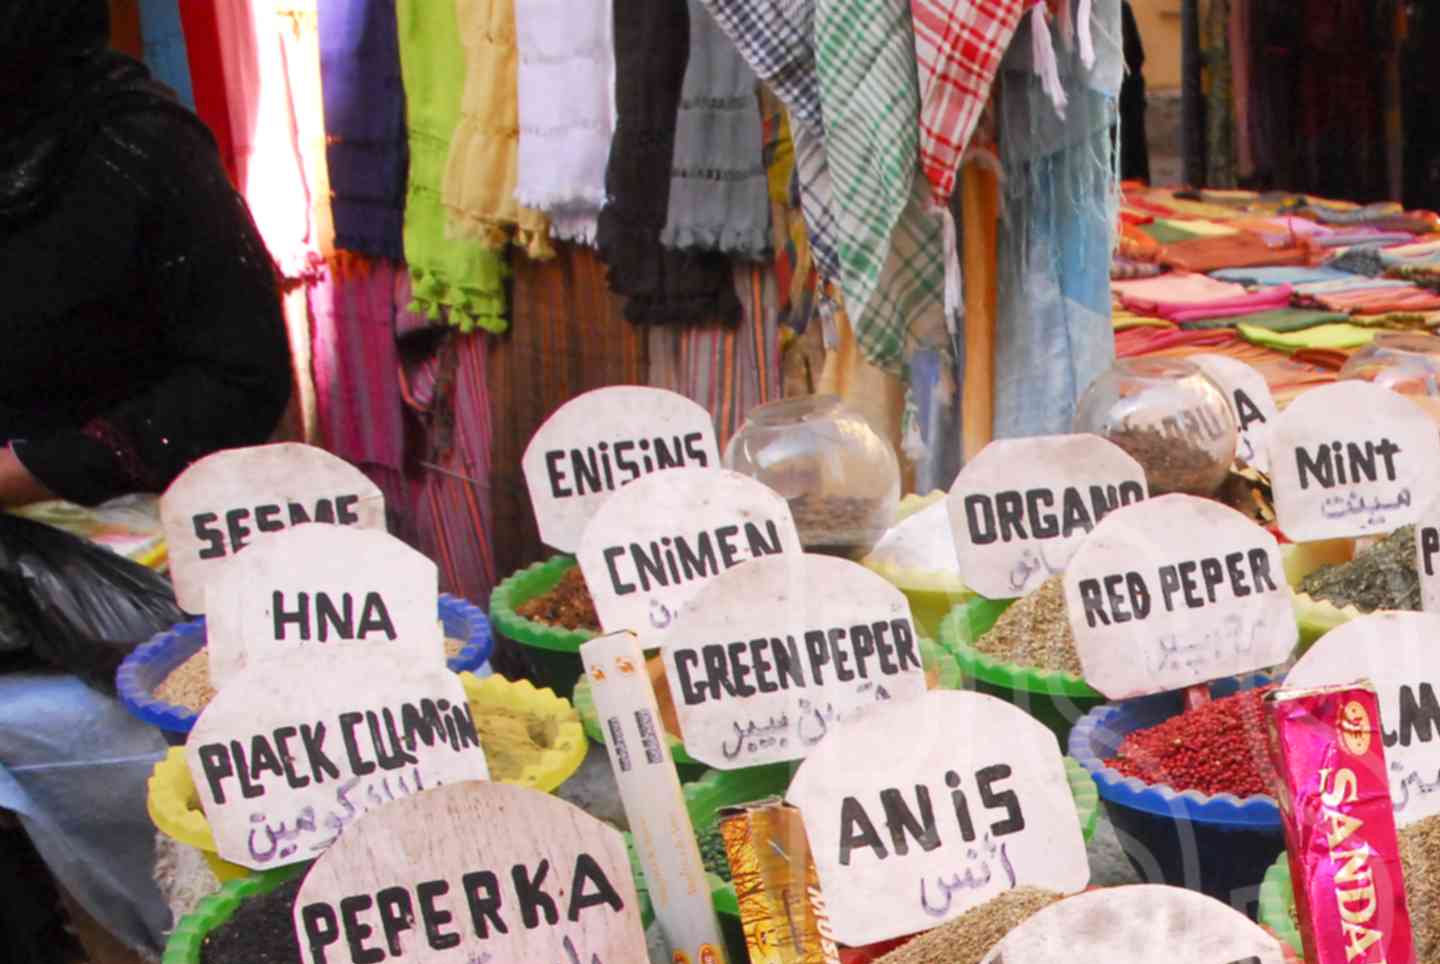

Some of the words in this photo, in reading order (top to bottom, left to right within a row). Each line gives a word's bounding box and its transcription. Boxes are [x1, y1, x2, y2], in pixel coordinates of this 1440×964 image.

[272, 590, 398, 642] HNA
[1079, 571, 1152, 628] RED
[1158, 548, 1278, 612] PEPER
[674, 635, 806, 705] GREEN
[804, 618, 921, 686] PEPER
